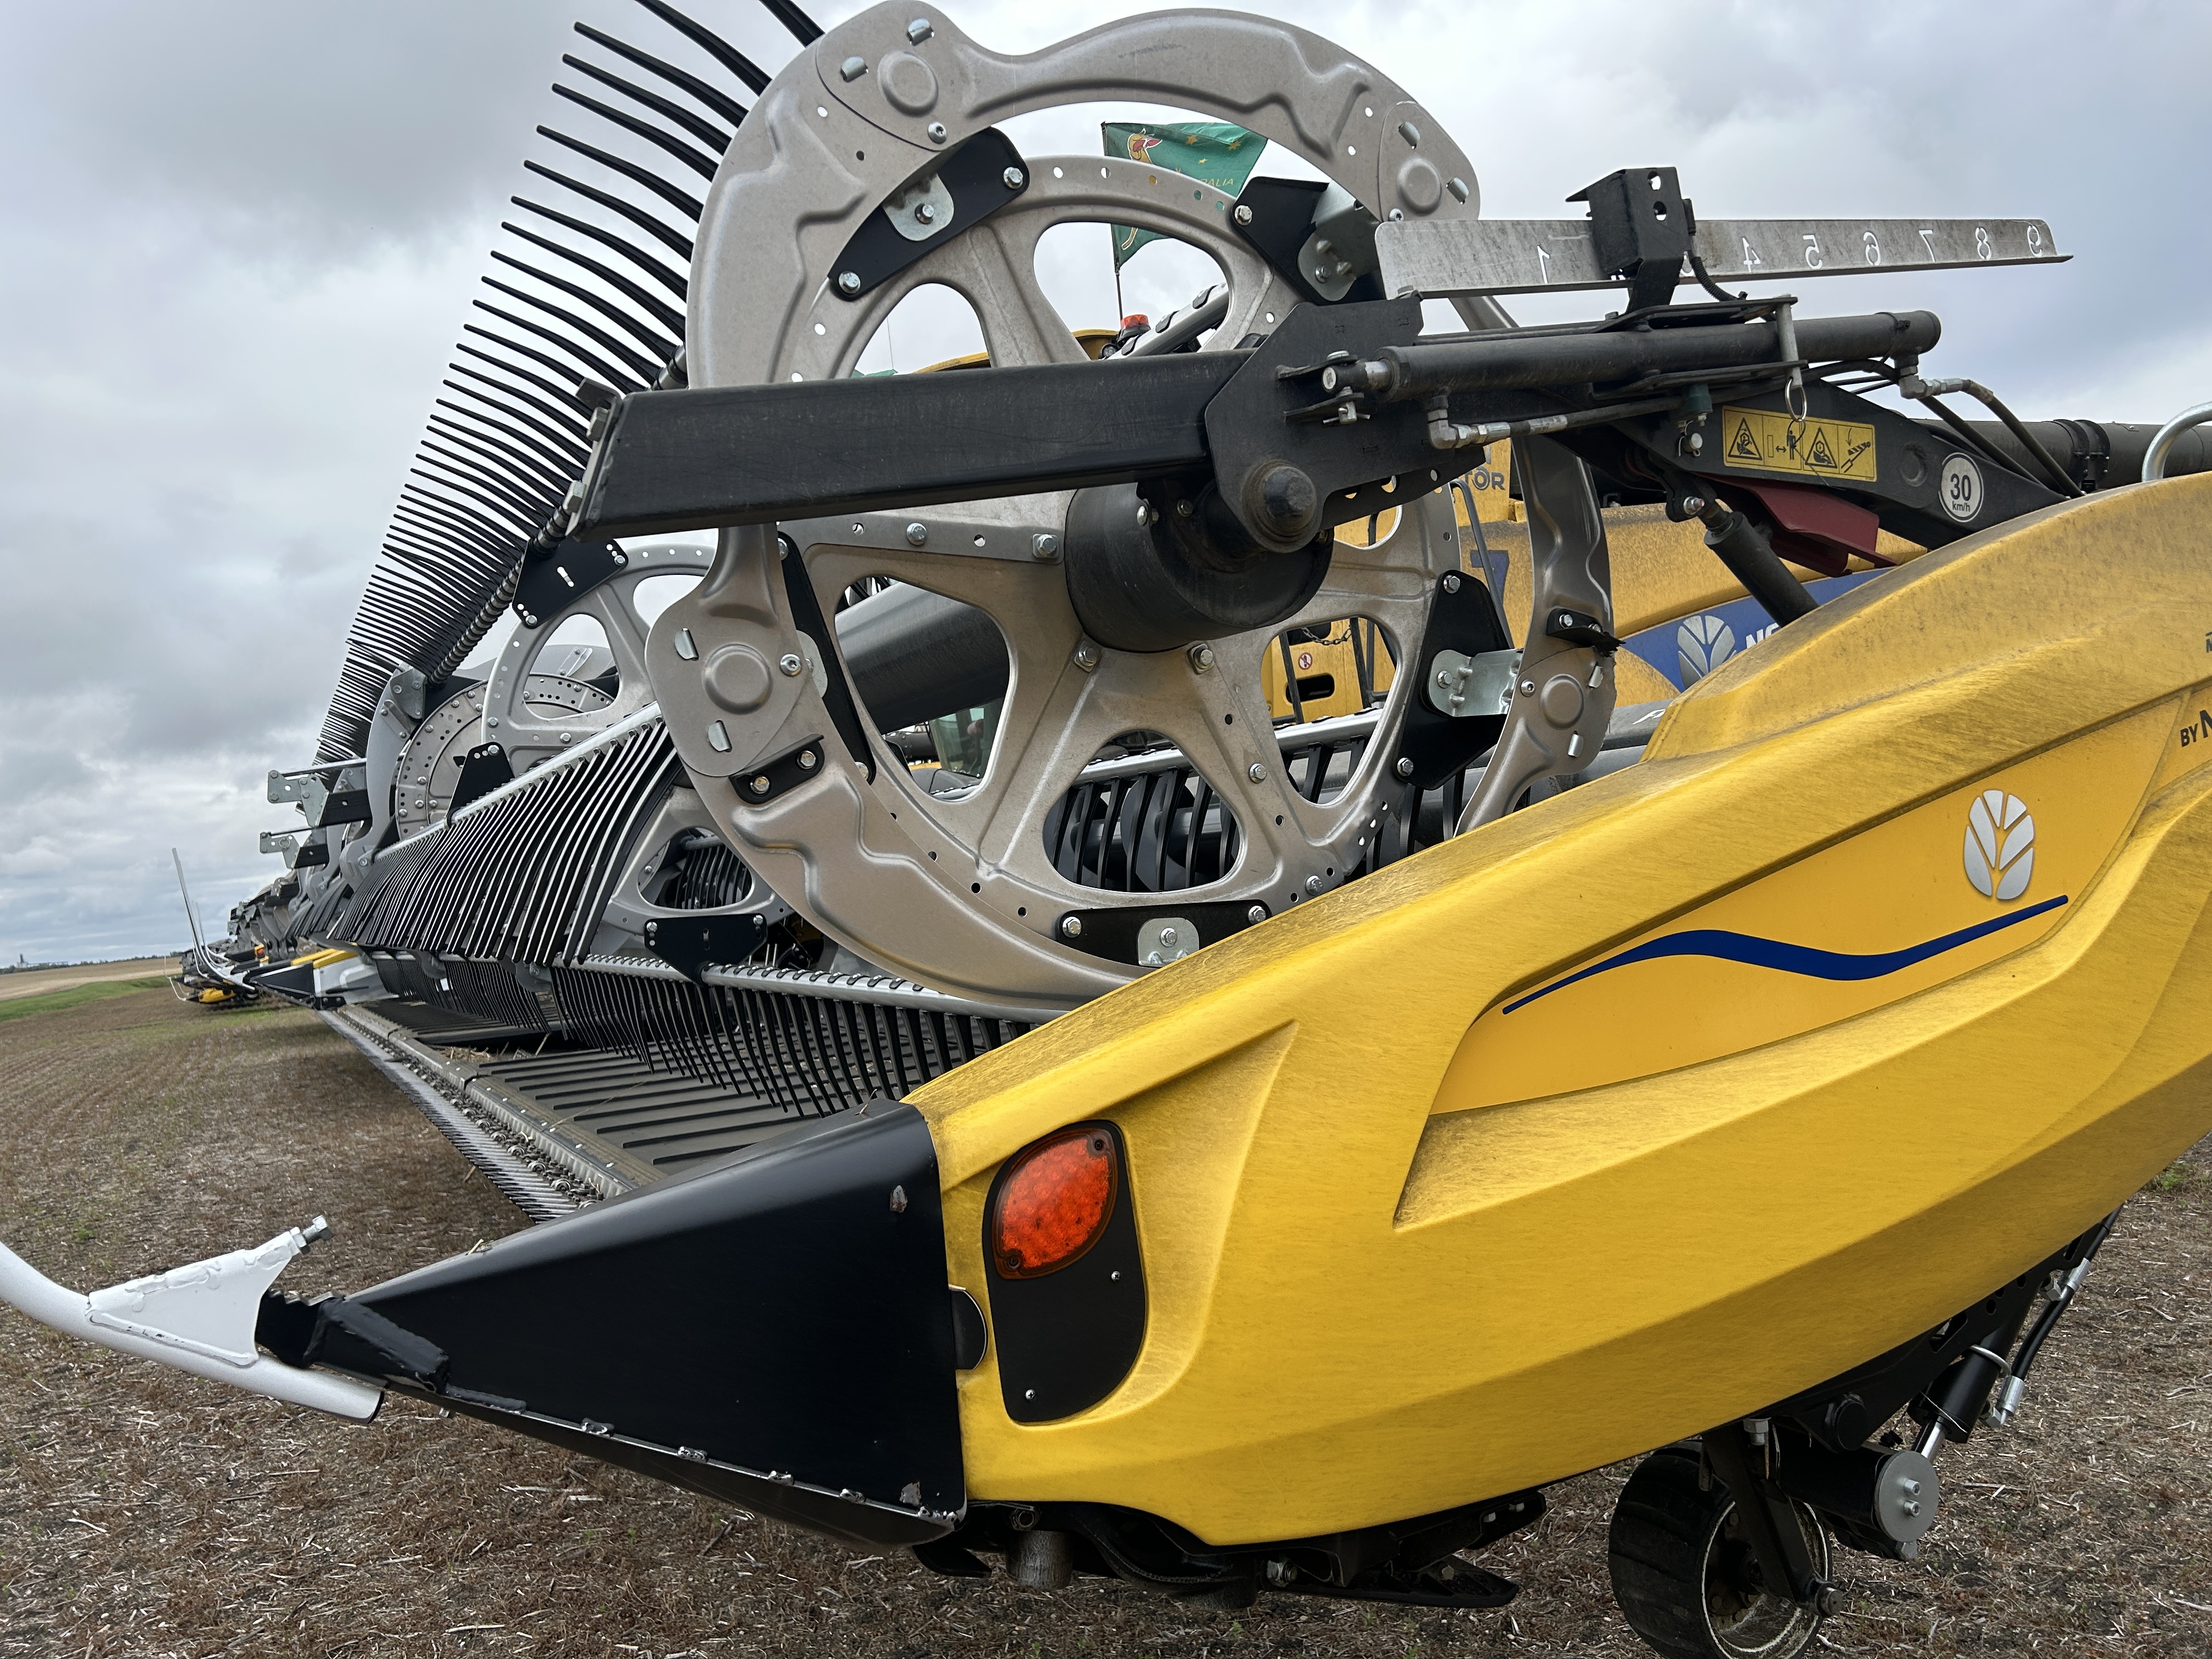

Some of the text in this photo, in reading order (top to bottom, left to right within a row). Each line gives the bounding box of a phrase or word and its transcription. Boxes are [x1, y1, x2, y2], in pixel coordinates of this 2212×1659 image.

[1950, 473, 1971, 501] 30
[1952, 501, 1971, 512] km/h
[2180, 724, 2198, 747] BY
